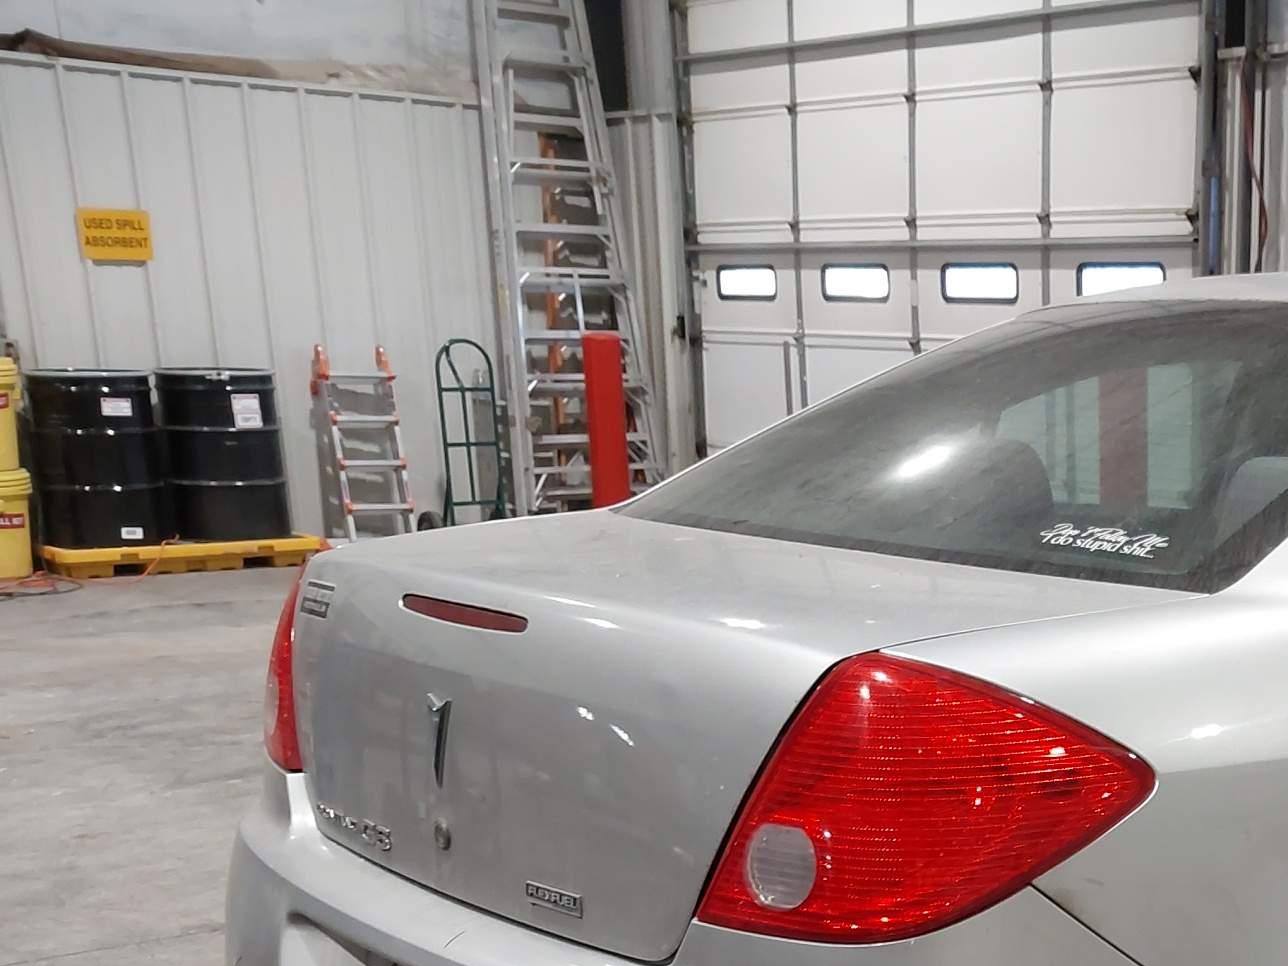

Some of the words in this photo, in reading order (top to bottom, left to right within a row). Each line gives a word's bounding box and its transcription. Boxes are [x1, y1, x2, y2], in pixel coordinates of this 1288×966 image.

[83, 217, 112, 230] USED
[115, 218, 145, 231] SPILL
[85, 236, 148, 249] ABSORBENT
[1050, 531, 1074, 545] do
[1072, 535, 1124, 552] stupid
